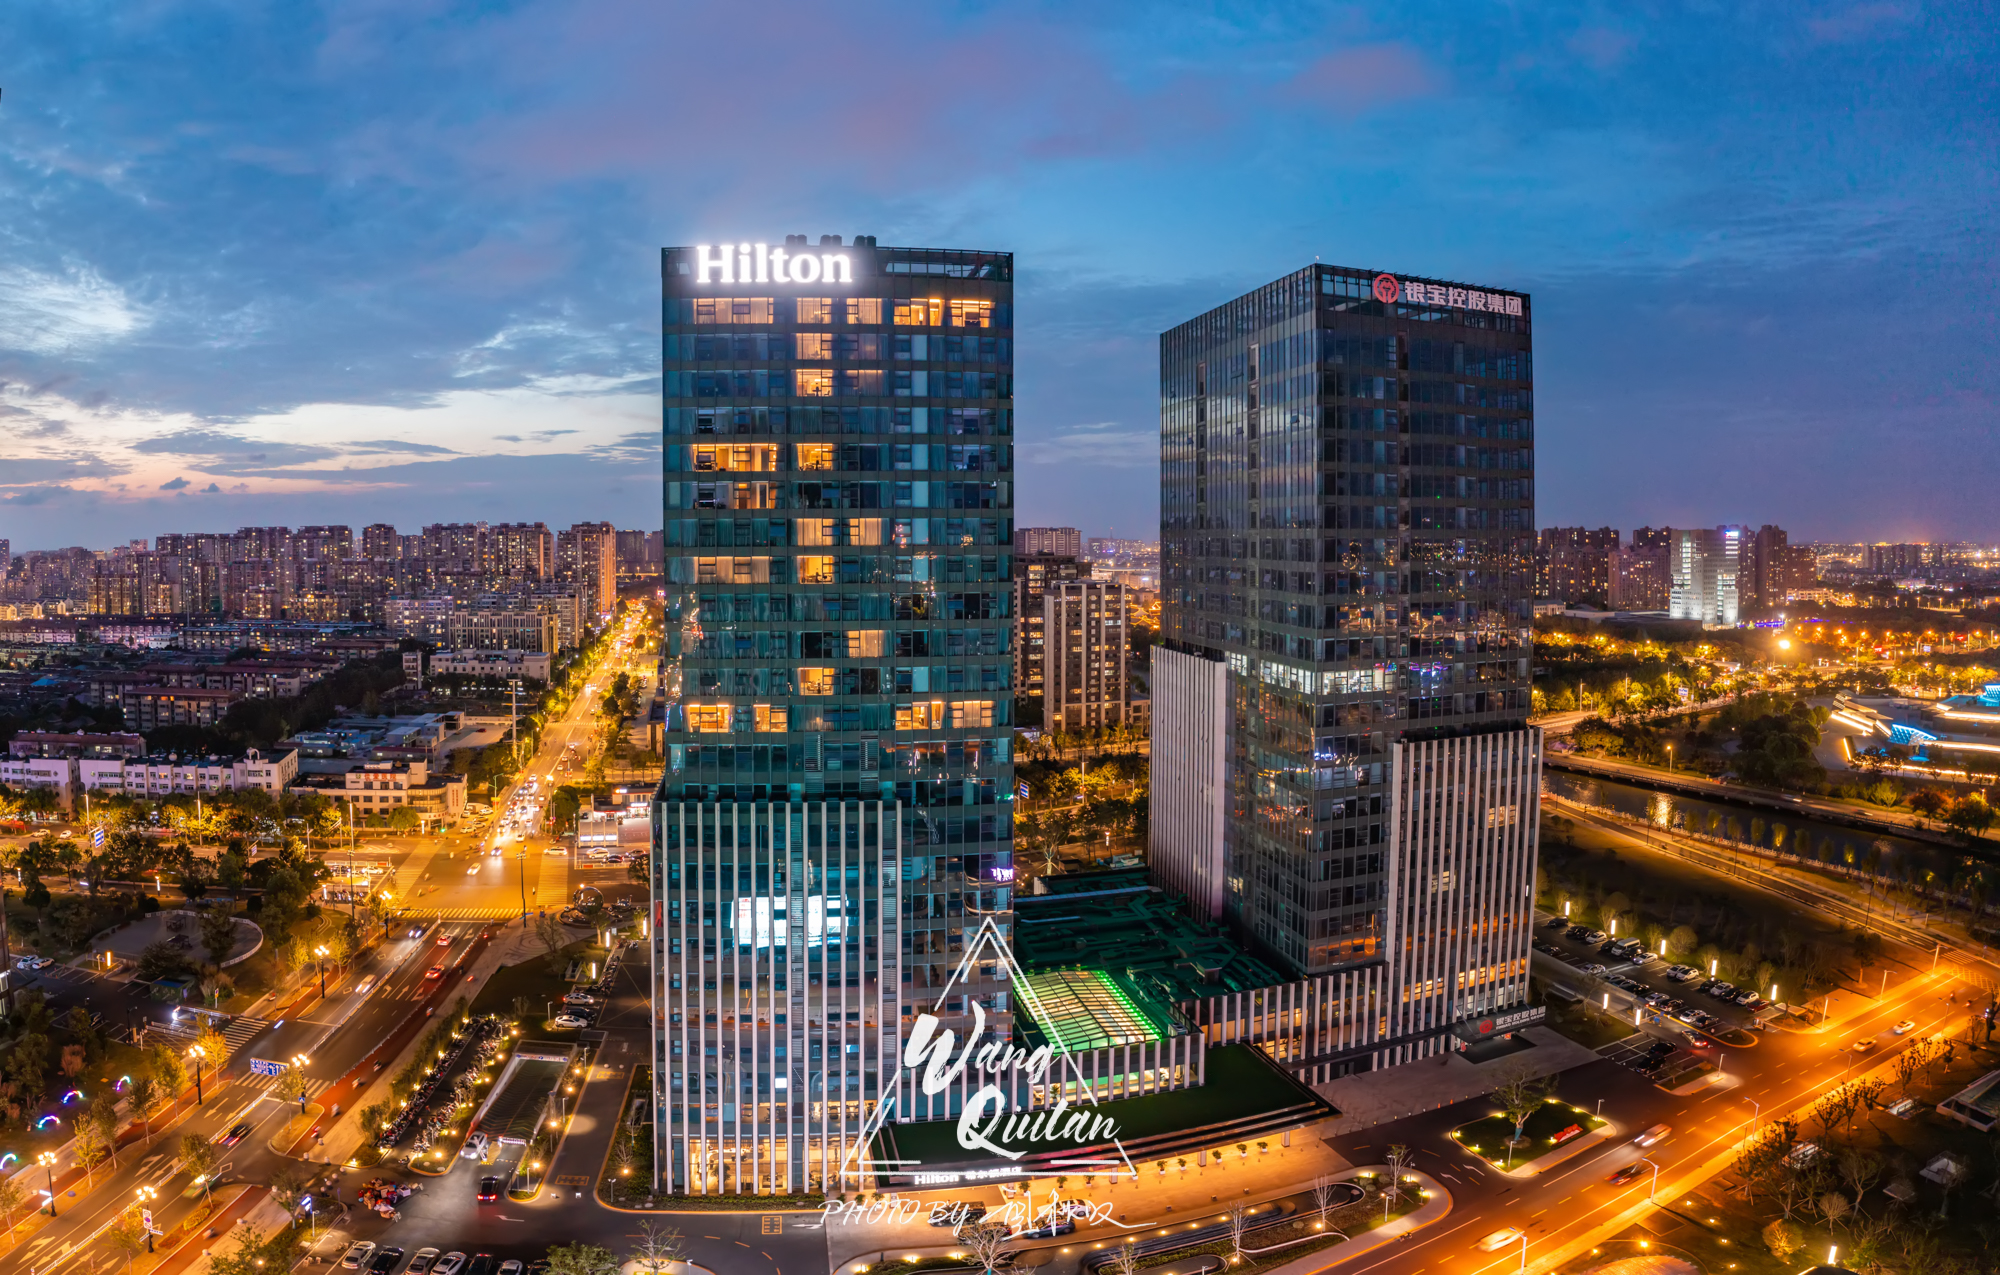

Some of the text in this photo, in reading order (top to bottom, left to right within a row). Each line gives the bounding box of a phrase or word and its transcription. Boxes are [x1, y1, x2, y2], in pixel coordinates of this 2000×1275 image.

[697, 243, 852, 283] Hilton
[1404, 281, 1523, 317] 银宝控股集团
[914, 1174, 959, 1185] Hilton
